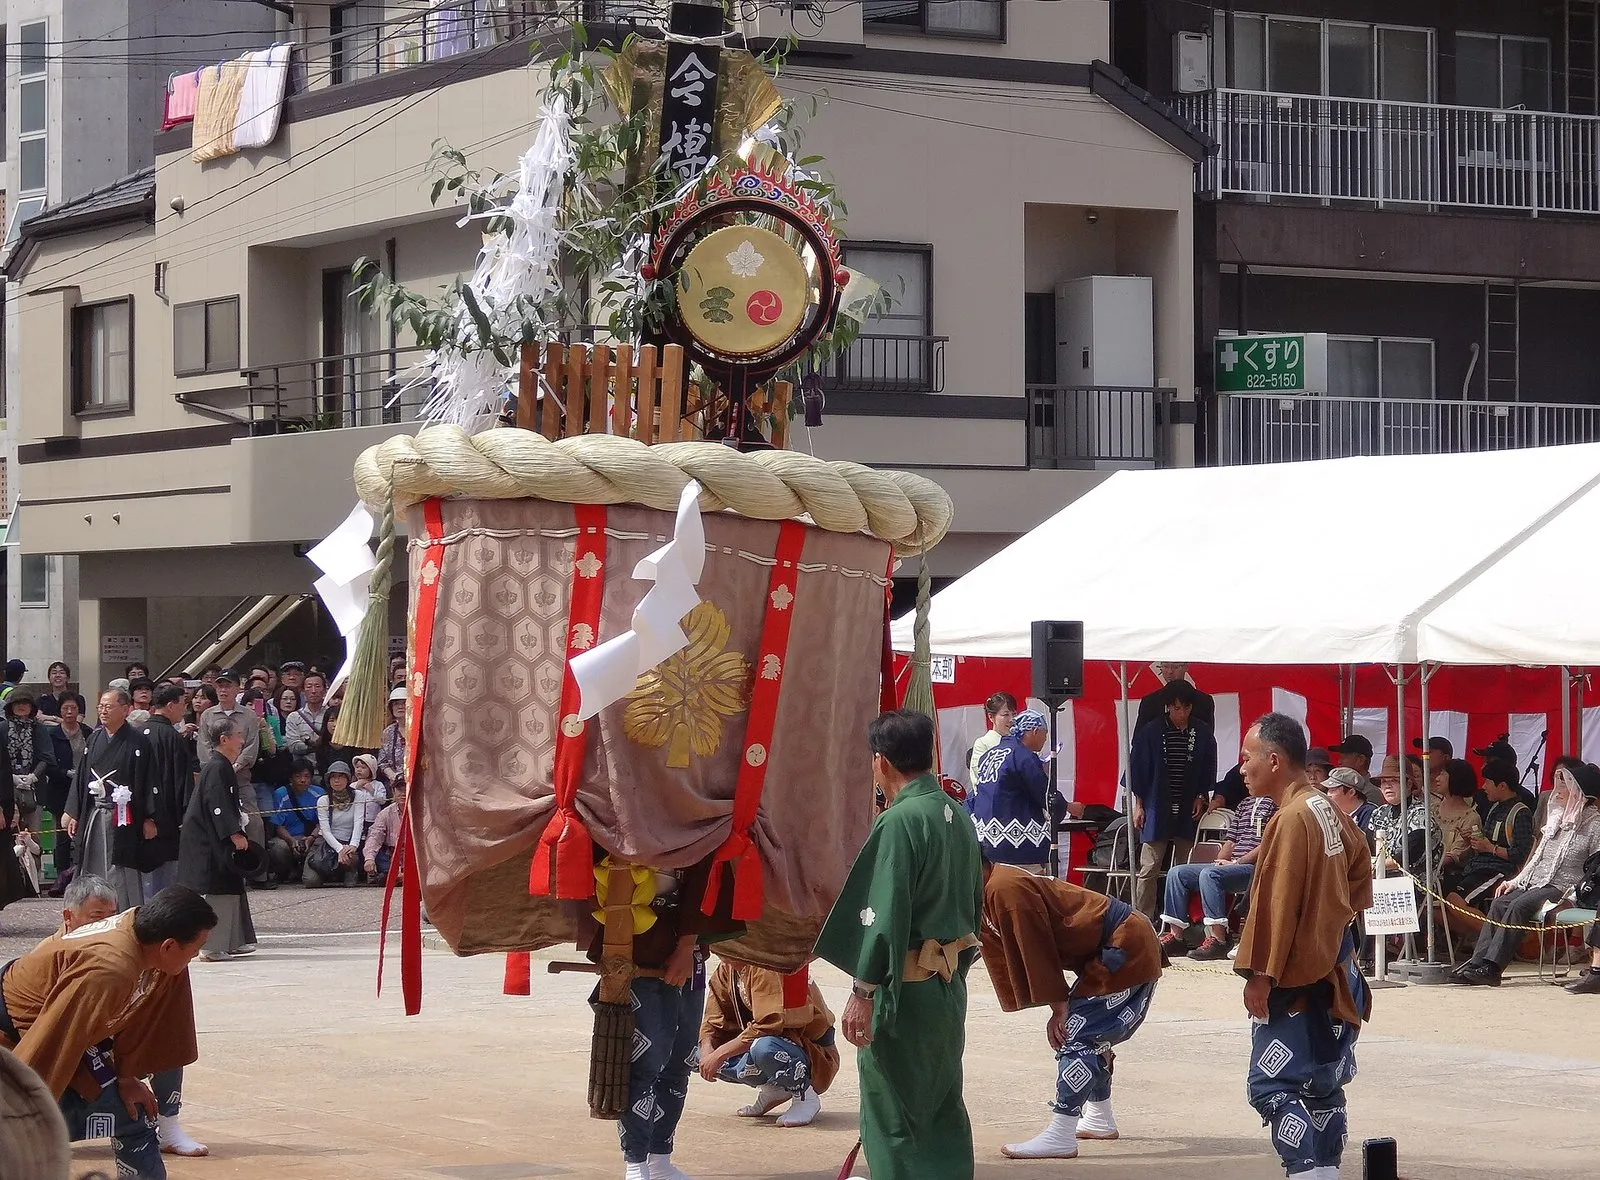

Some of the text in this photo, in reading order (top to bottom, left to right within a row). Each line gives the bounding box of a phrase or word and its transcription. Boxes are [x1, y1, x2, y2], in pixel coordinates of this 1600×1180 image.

[1243, 340, 1300, 371] くすり
[1246, 373, 1297, 388] 822-5150
[932, 656, 953, 680] 本部
